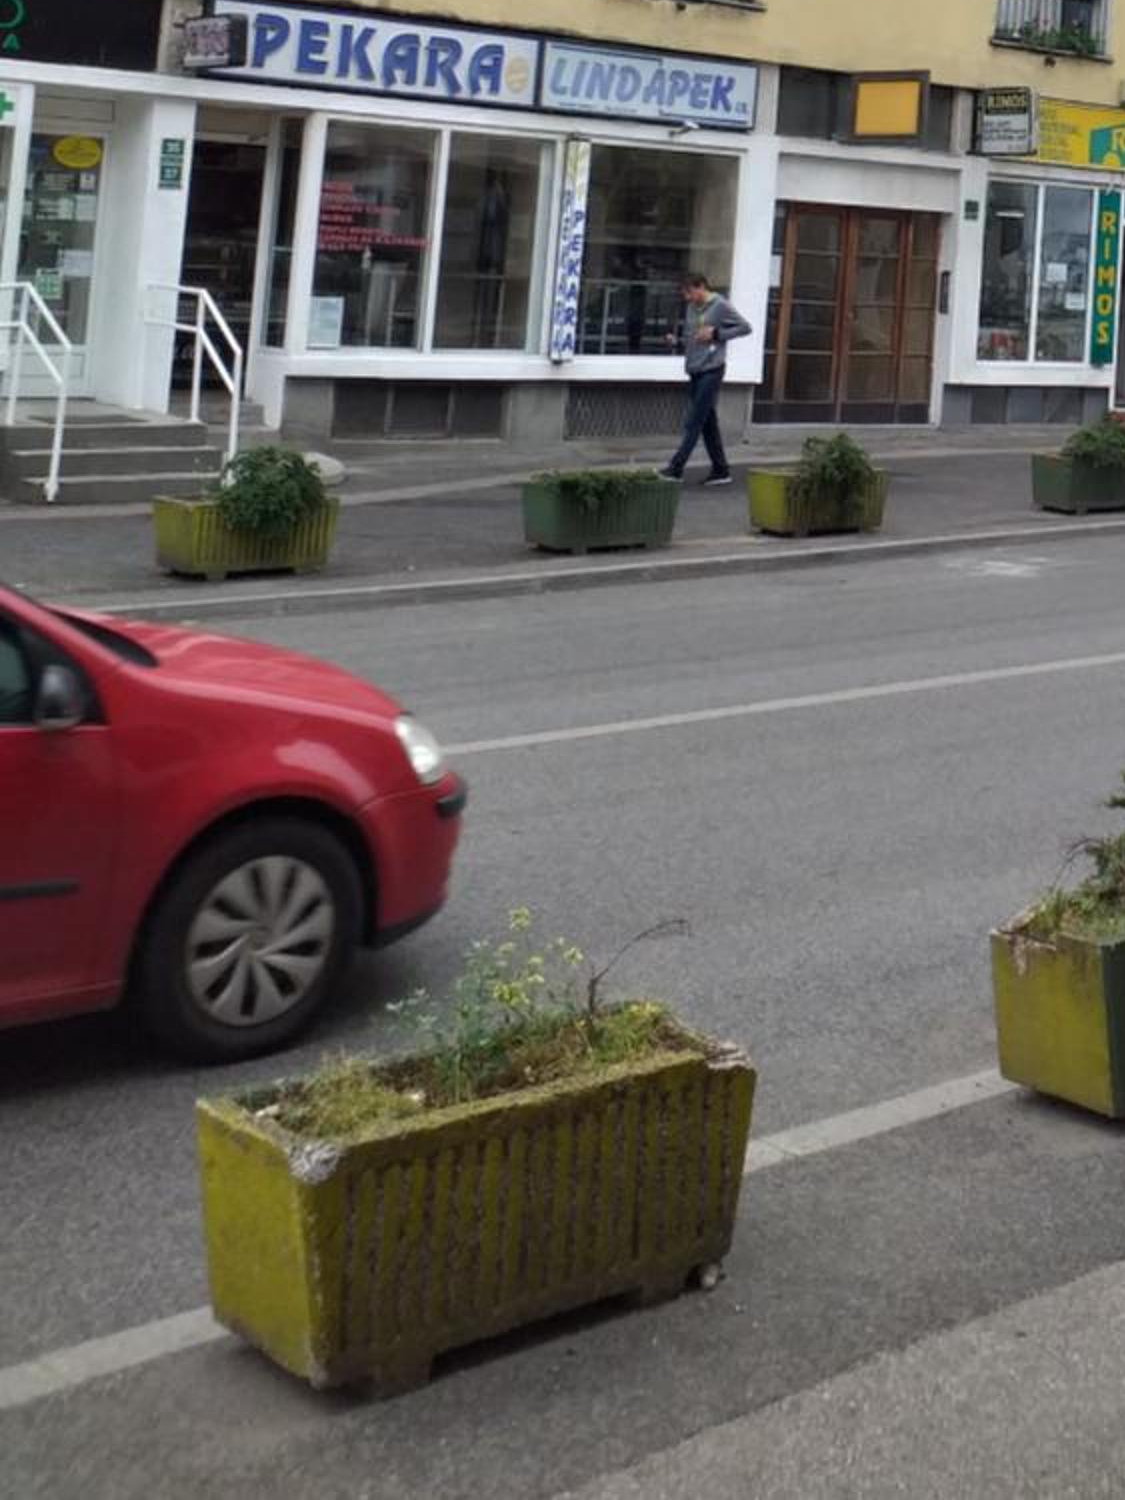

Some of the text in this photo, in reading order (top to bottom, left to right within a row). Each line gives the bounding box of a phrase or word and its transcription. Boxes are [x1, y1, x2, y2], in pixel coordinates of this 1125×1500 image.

[250, 13, 505, 97] PEKARA
[987, 95, 1025, 109] RIMOS
[562, 210, 586, 350] PEKARA
[1097, 211, 1117, 345] RIMOS
